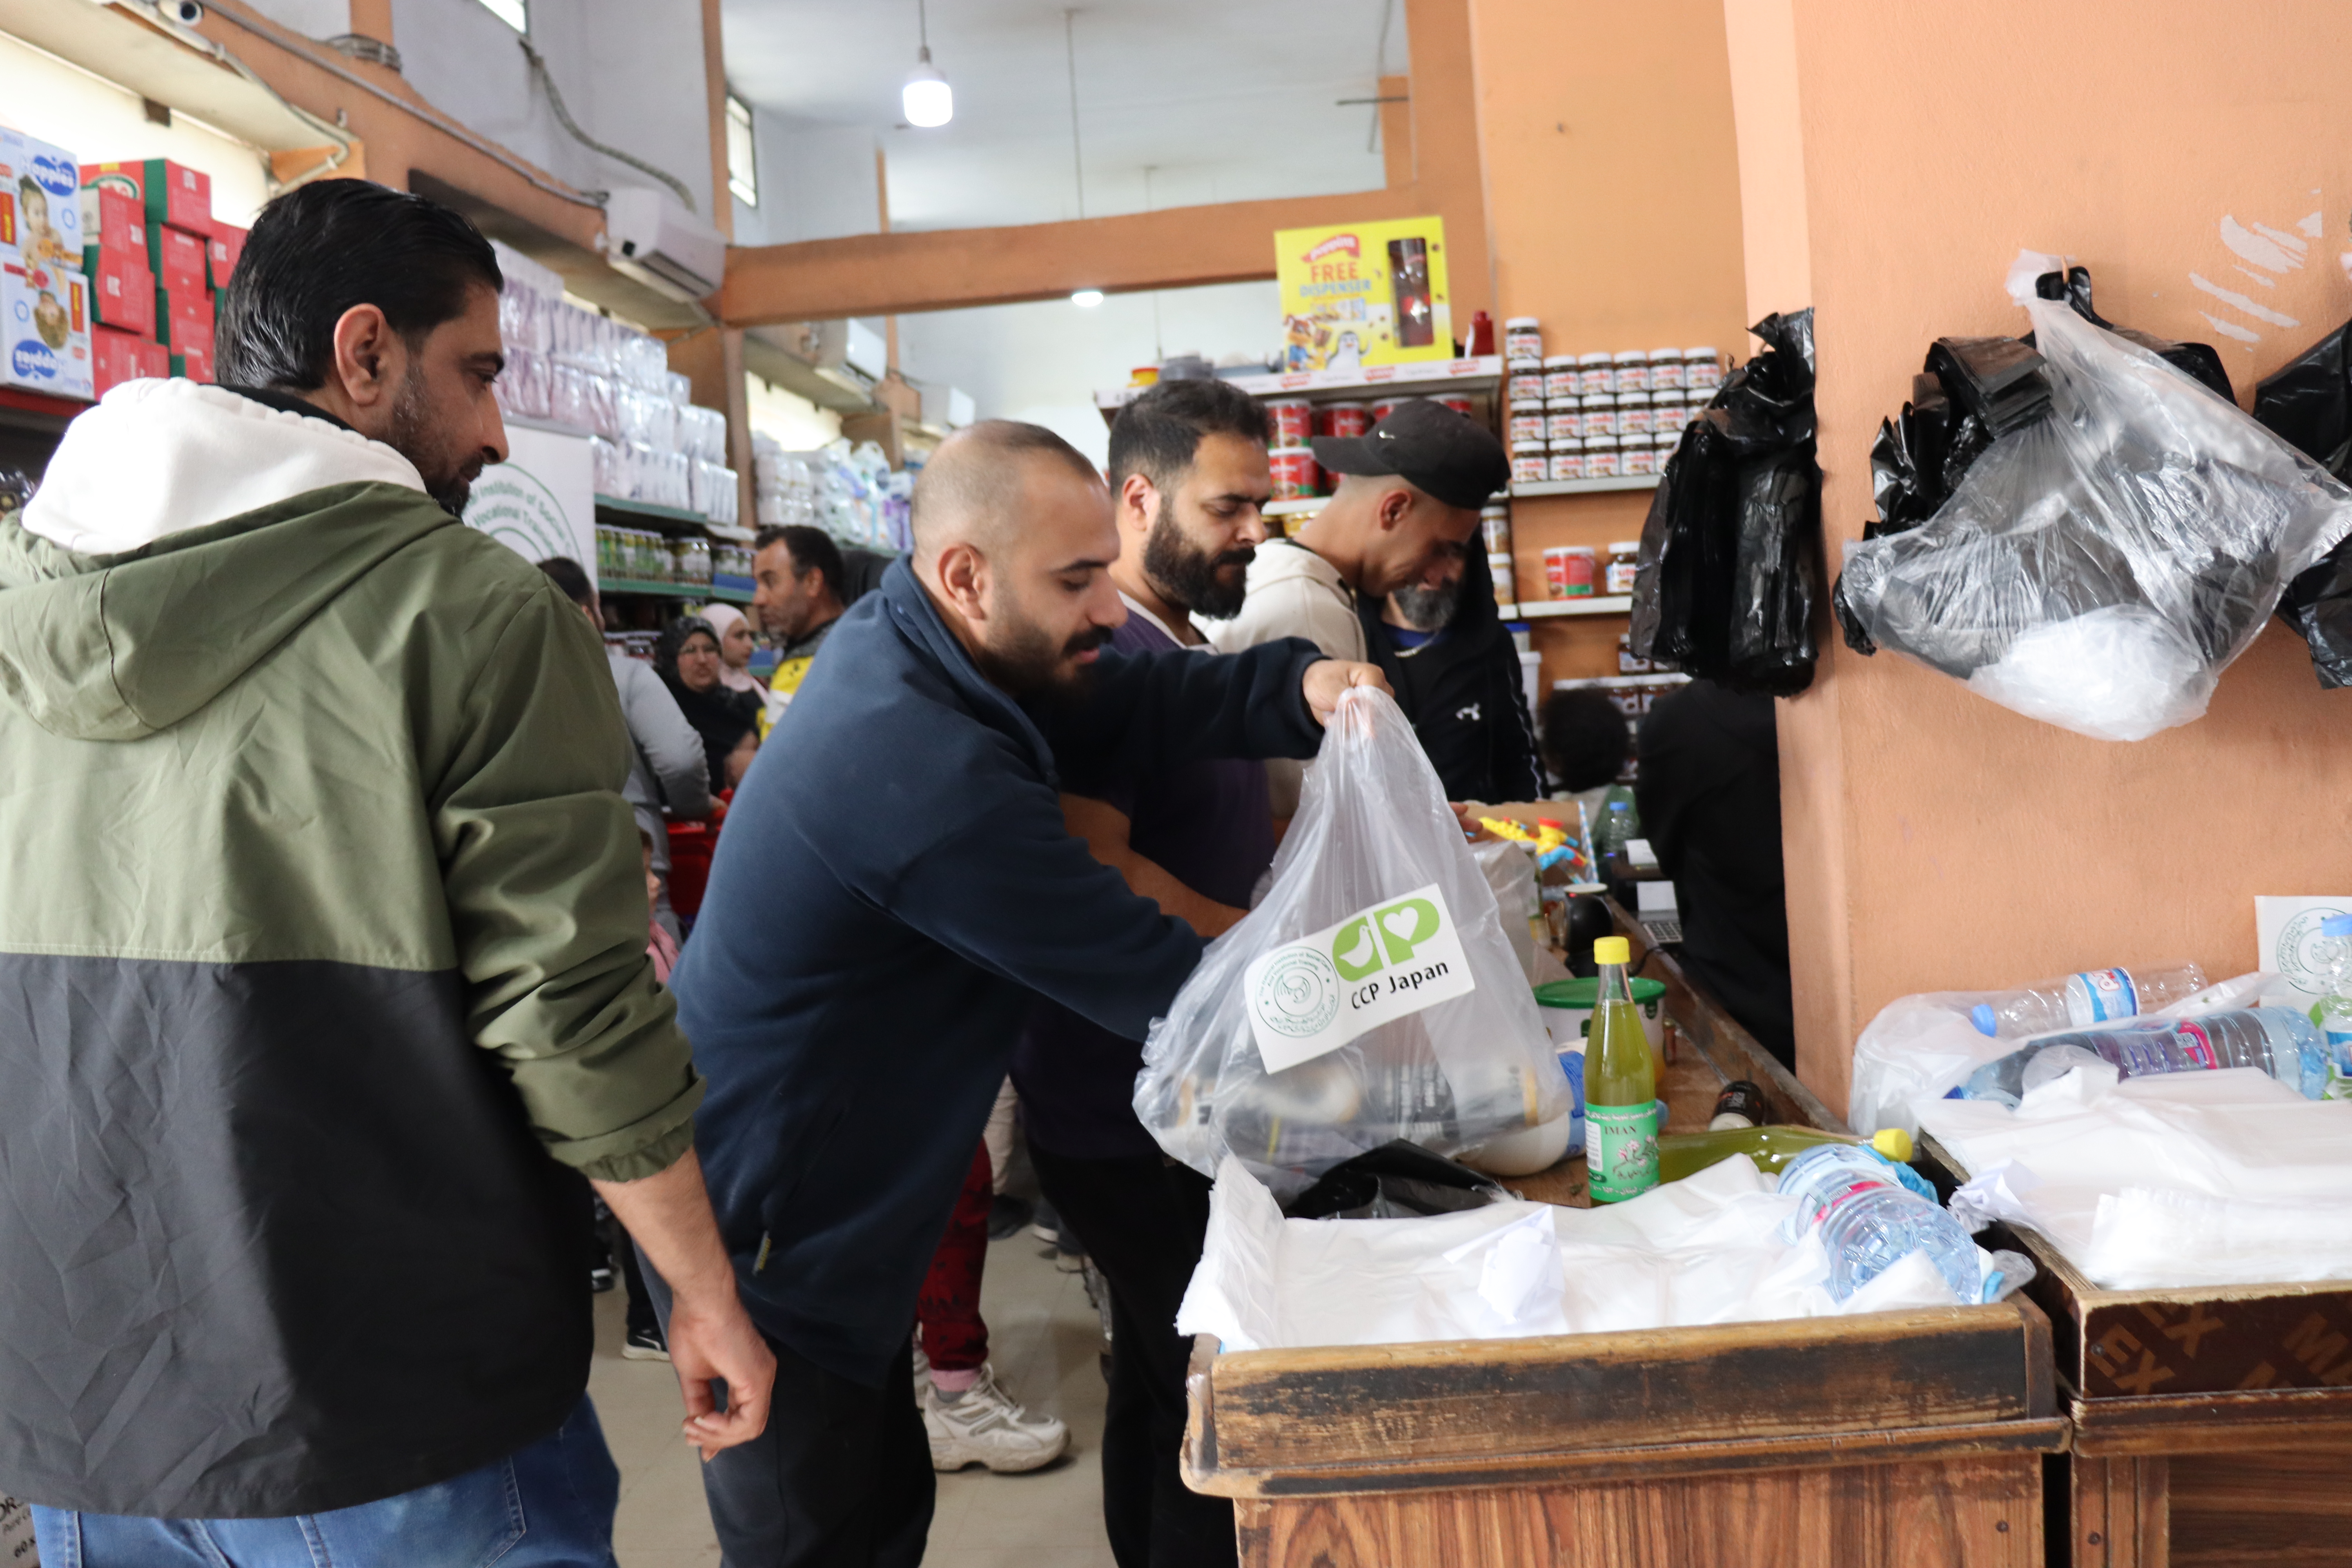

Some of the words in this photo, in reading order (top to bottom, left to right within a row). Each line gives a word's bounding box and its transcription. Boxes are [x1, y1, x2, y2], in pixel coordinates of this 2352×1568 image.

[1311, 261, 1359, 283] FREE
[1299, 279, 1371, 297] DISPENSER
[1351, 982, 1379, 1009] CCP
[1388, 962, 1449, 994] Japan
